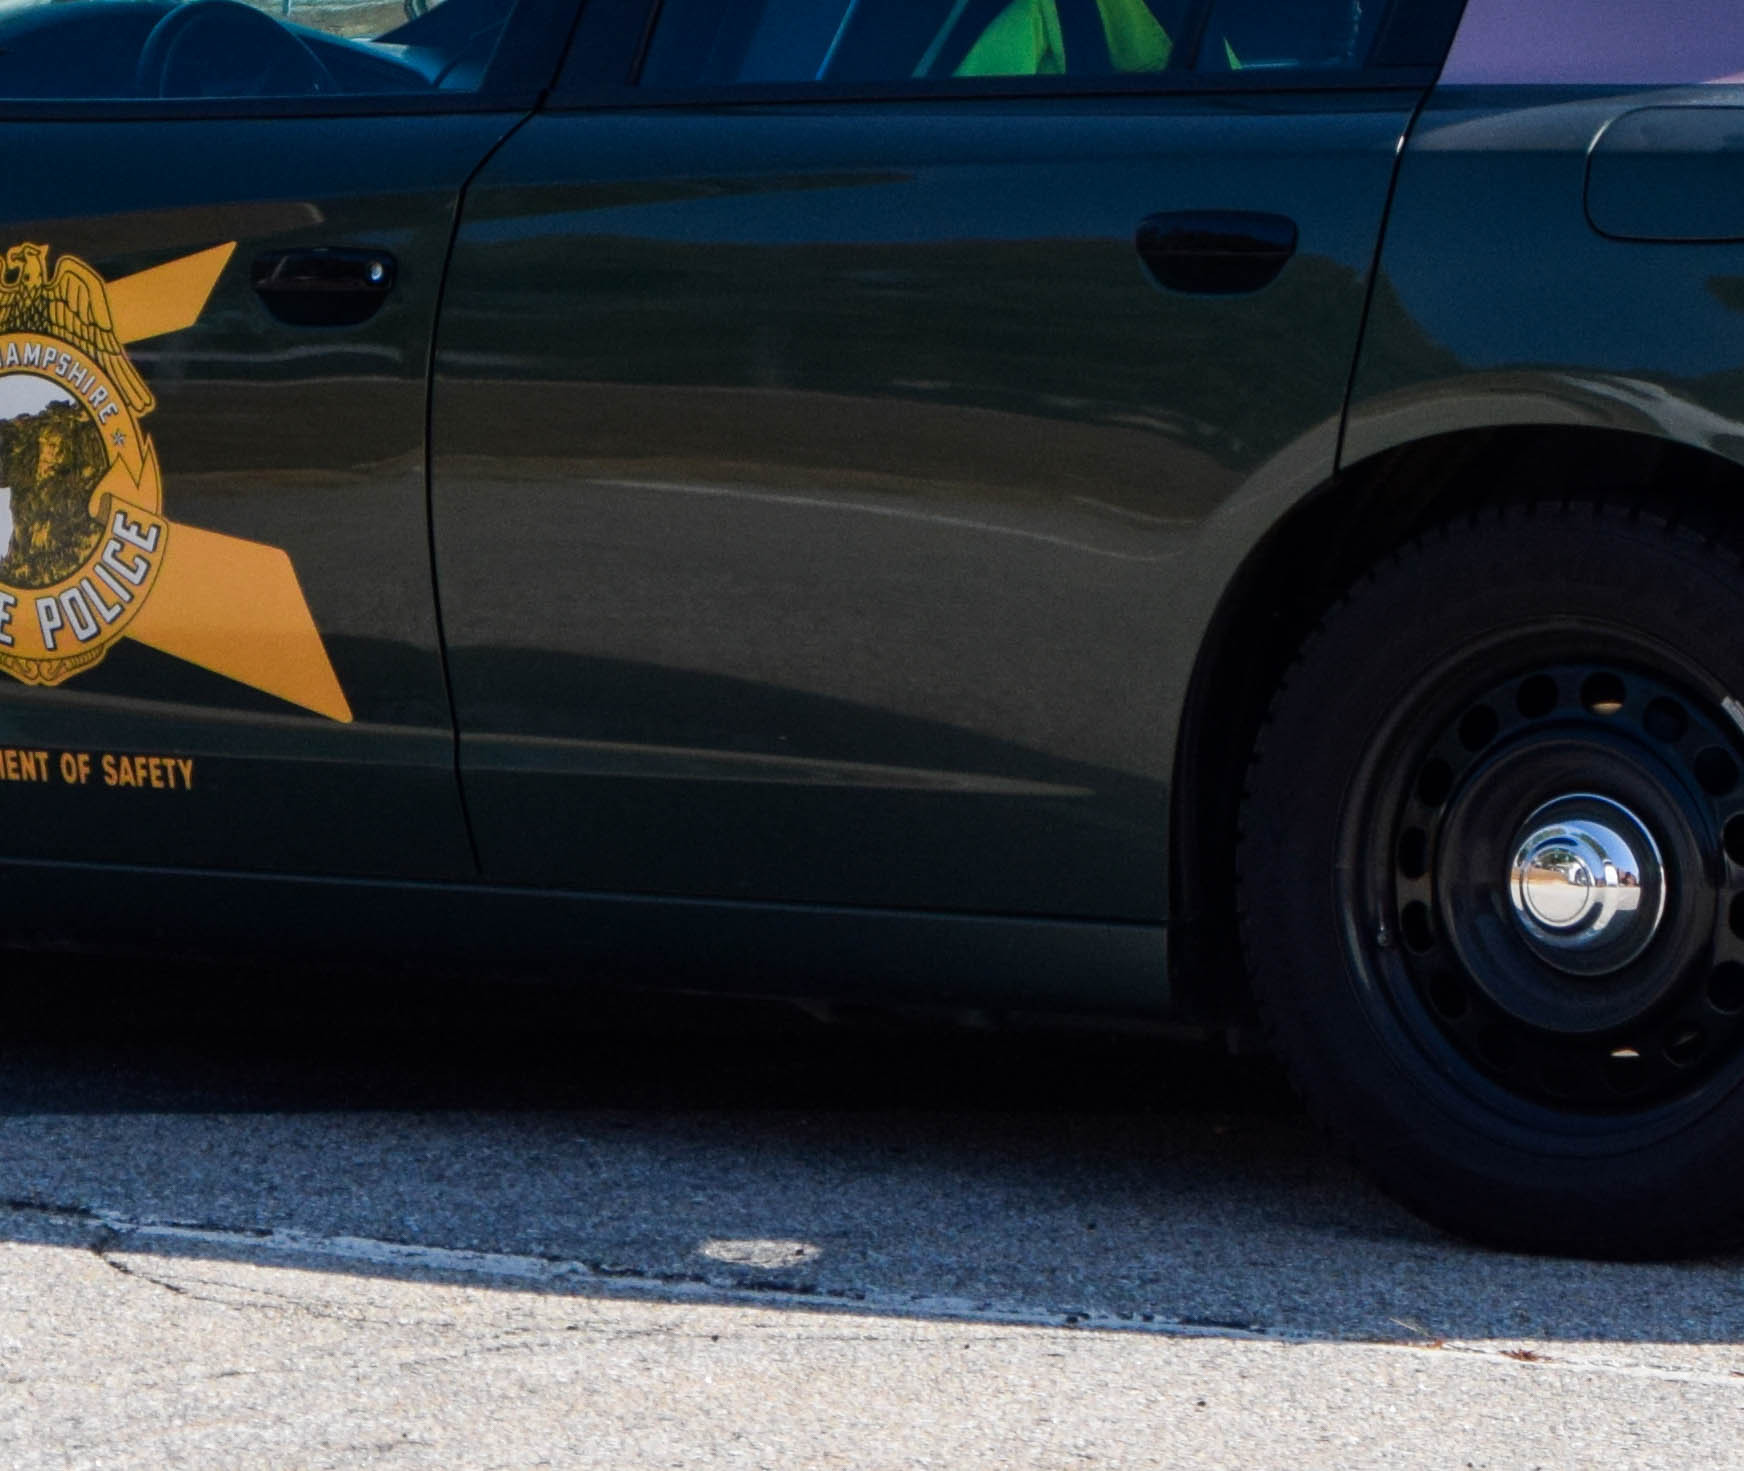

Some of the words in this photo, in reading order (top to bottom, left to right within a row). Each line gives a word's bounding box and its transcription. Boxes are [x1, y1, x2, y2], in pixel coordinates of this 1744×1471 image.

[35, 511, 161, 650] POLICE
[60, 752, 91, 784] OF
[102, 755, 193, 790] SAFETY
